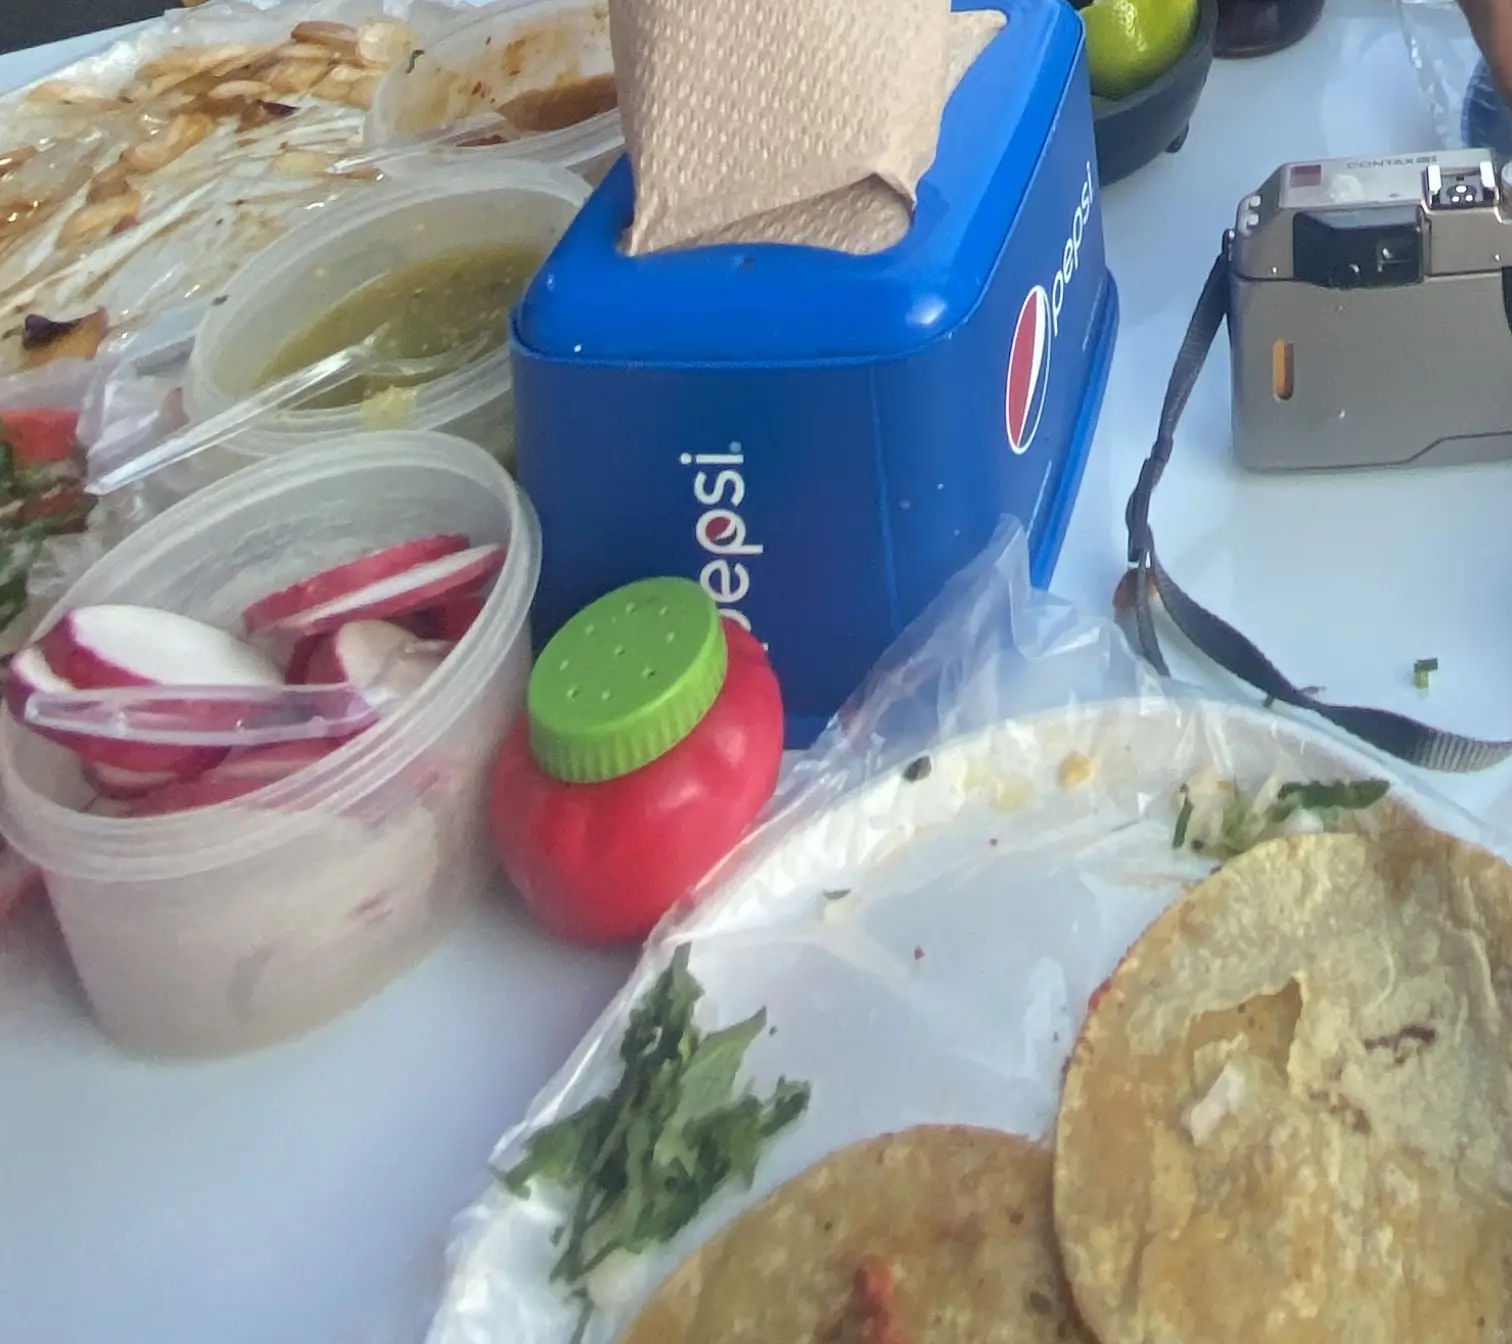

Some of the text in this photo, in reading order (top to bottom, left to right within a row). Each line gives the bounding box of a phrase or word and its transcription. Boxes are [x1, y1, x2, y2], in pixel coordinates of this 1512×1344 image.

[1051, 160, 1094, 337] pepsi
[1346, 158, 1414, 170] CONTAX
[678, 451, 769, 652] epsi
